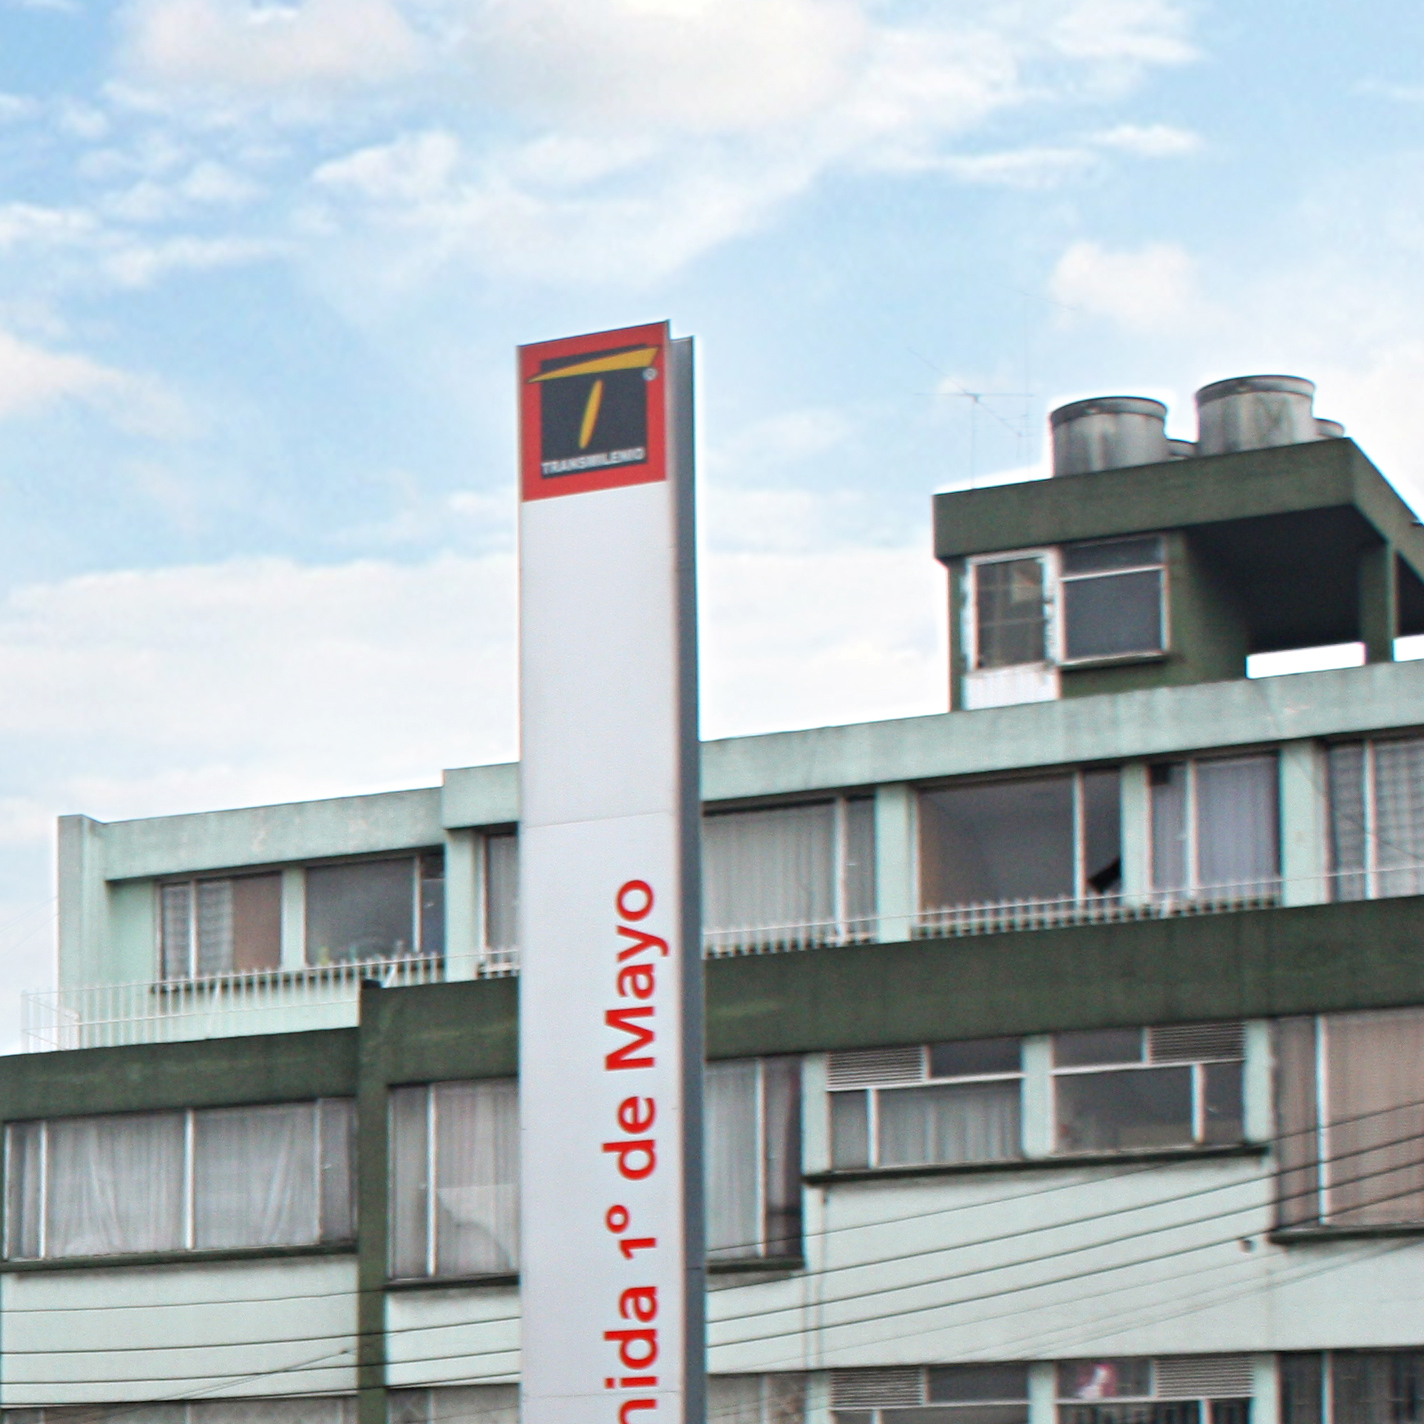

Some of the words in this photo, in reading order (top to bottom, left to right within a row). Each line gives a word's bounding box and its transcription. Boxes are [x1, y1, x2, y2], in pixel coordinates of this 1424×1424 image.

[541, 447, 647, 477] TRANSMILENIO
[605, 879, 669, 1072] Mayo
[602, 1095, 658, 1181] de
